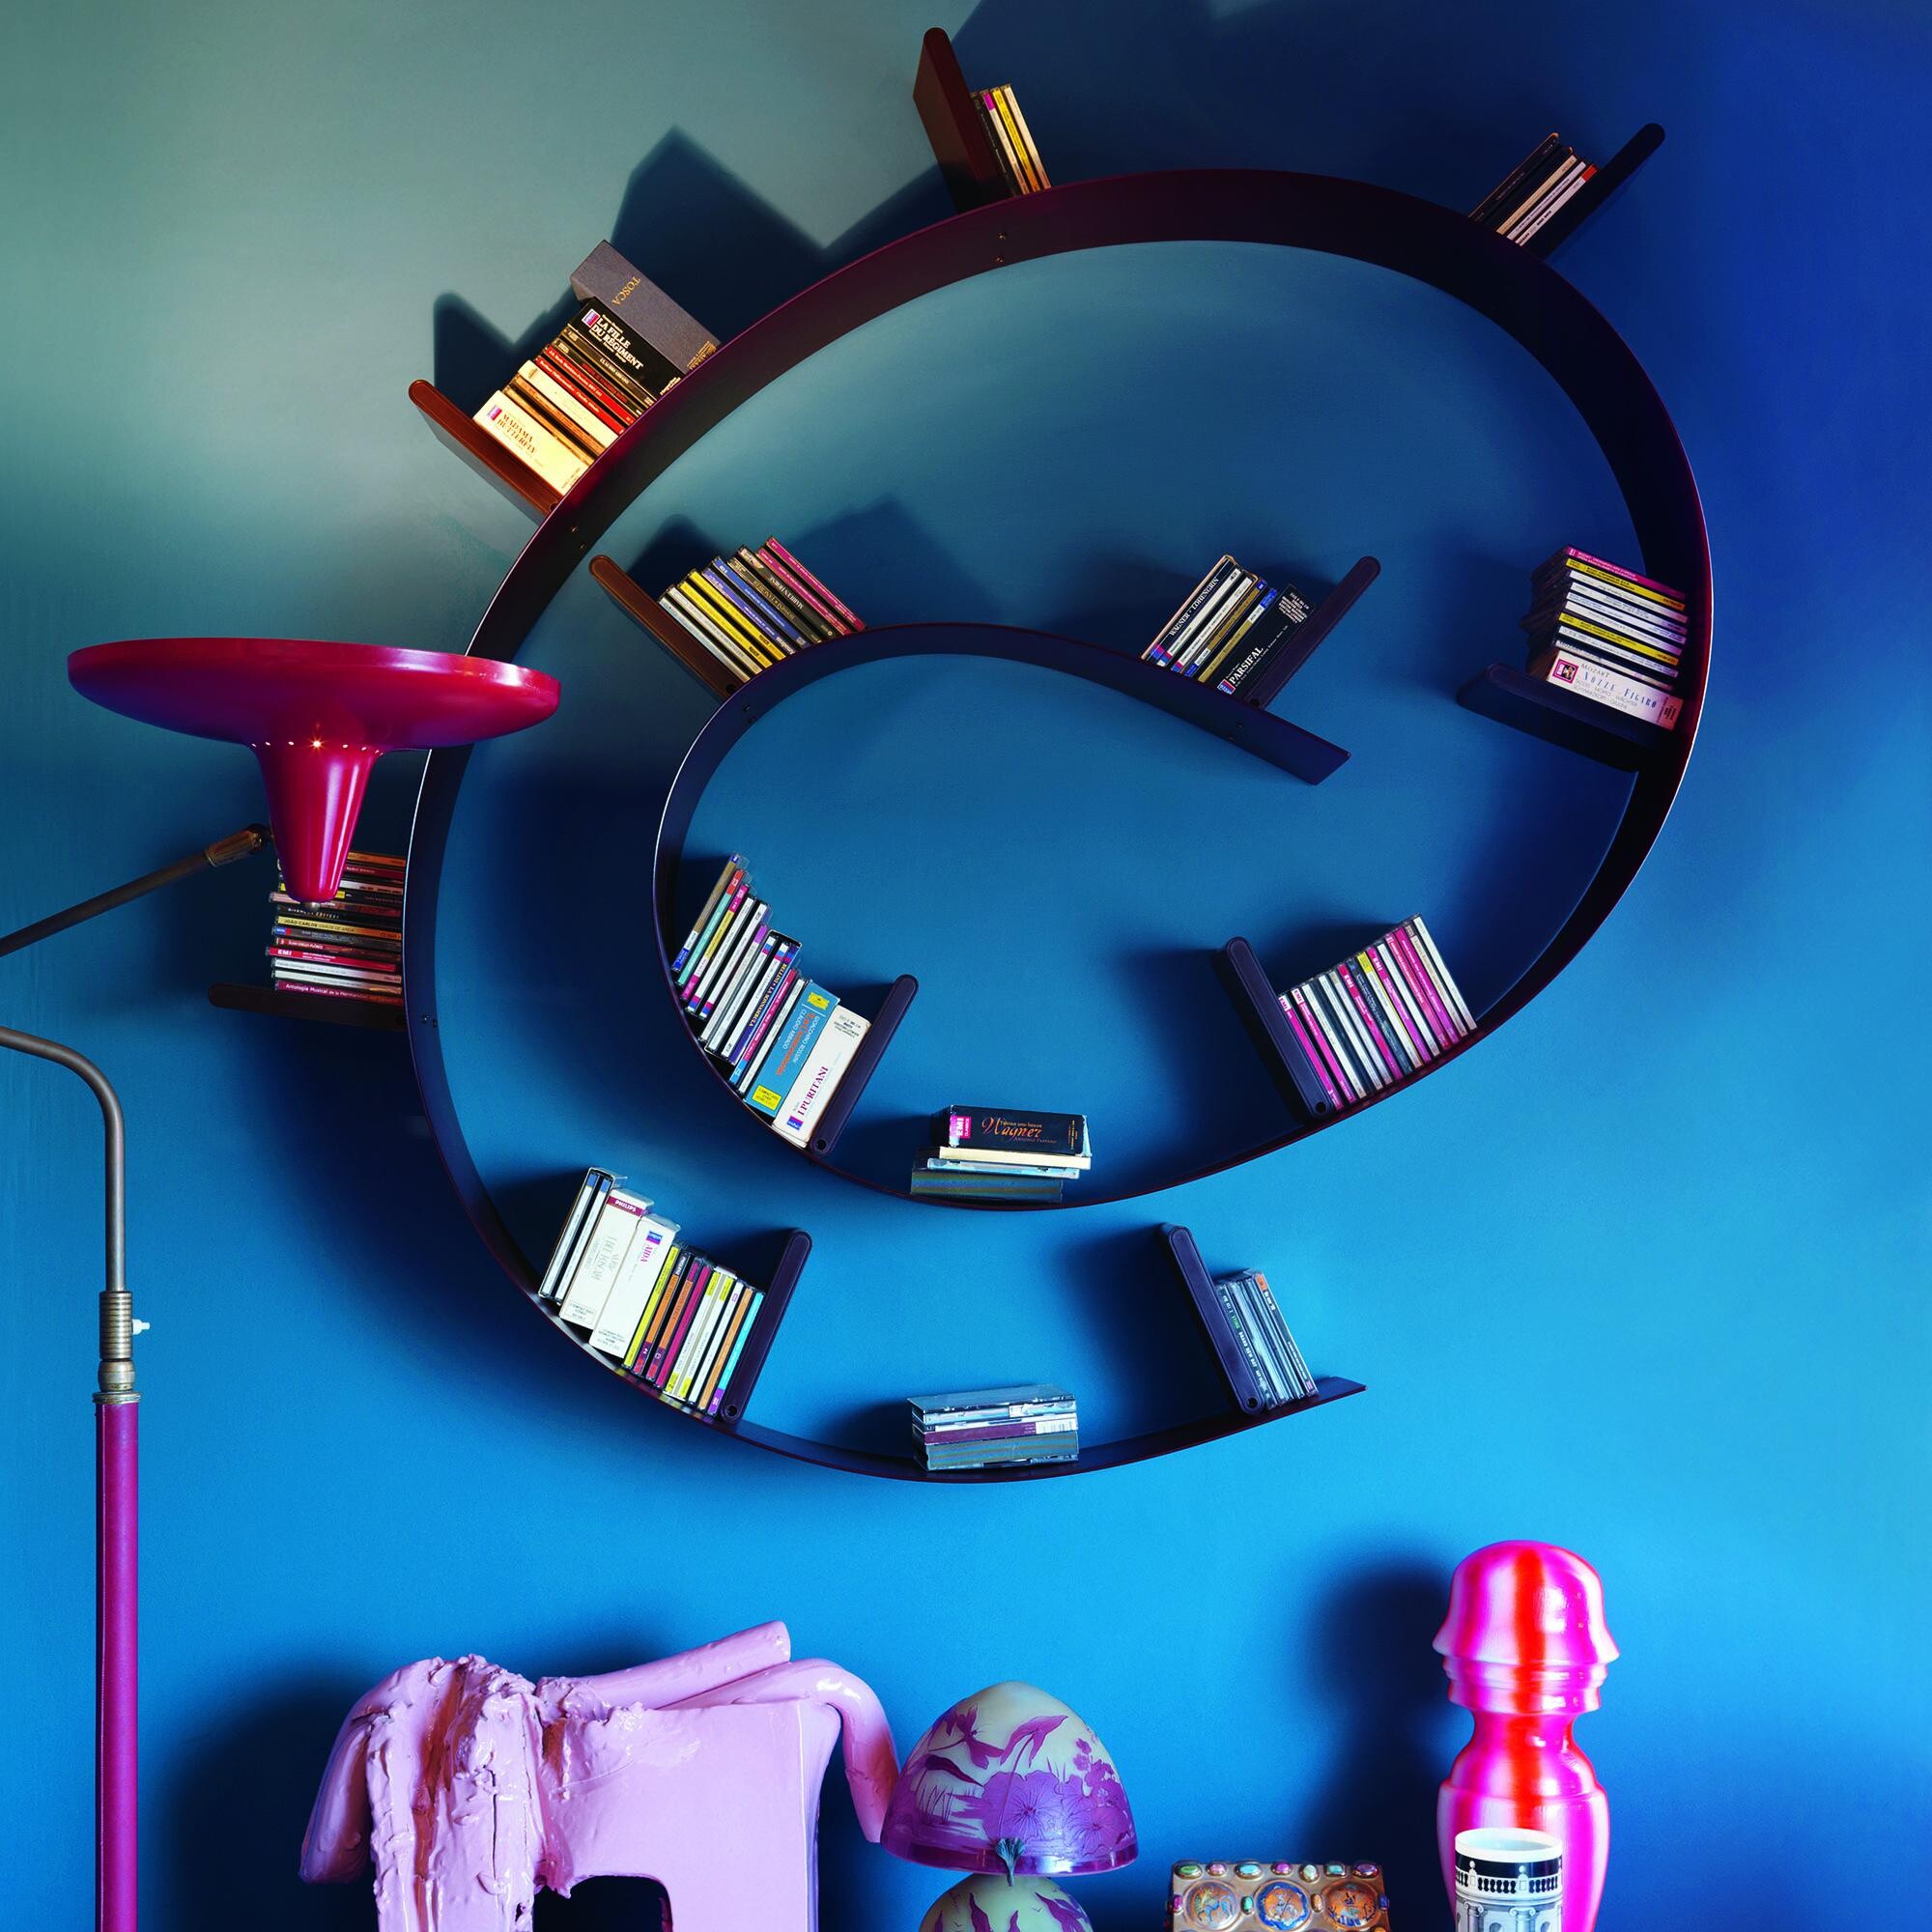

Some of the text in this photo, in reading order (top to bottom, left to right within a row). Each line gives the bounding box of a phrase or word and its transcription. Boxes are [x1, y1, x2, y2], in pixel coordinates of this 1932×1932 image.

[611, 275, 639, 306] TOSCA
[591, 324, 604, 336] DU
[603, 333, 642, 369] RÉGIMENT
[597, 318, 609, 329] LA
[607, 327, 630, 348] FILLE
[497, 419, 535, 453] BUTTERFLY
[501, 413, 533, 441] MADAMA
[782, 588, 803, 609] MARILYN
[1170, 612, 1189, 636] WAGNER
[1191, 577, 1218, 609] LOHENGRIN
[1229, 645, 1263, 683] PARSIFAL
[773, 963, 786, 982] BELLINI
[1372, 957, 1381, 970] EMI
[1344, 975, 1352, 987] EMI
[749, 994, 769, 1026] SONNAMBULA
[782, 1009, 806, 1049] CLAUDIO ABBADO
[792, 1016, 819, 1062] GIOACCHINO ROSSINI
[800, 1066, 827, 1110] PURITANI
[955, 1118, 964, 1136] EMI
[981, 1117, 1044, 1140] Wagner
[615, 1200, 636, 1211] PHILIPS
[639, 1244, 653, 1264] AIDA
